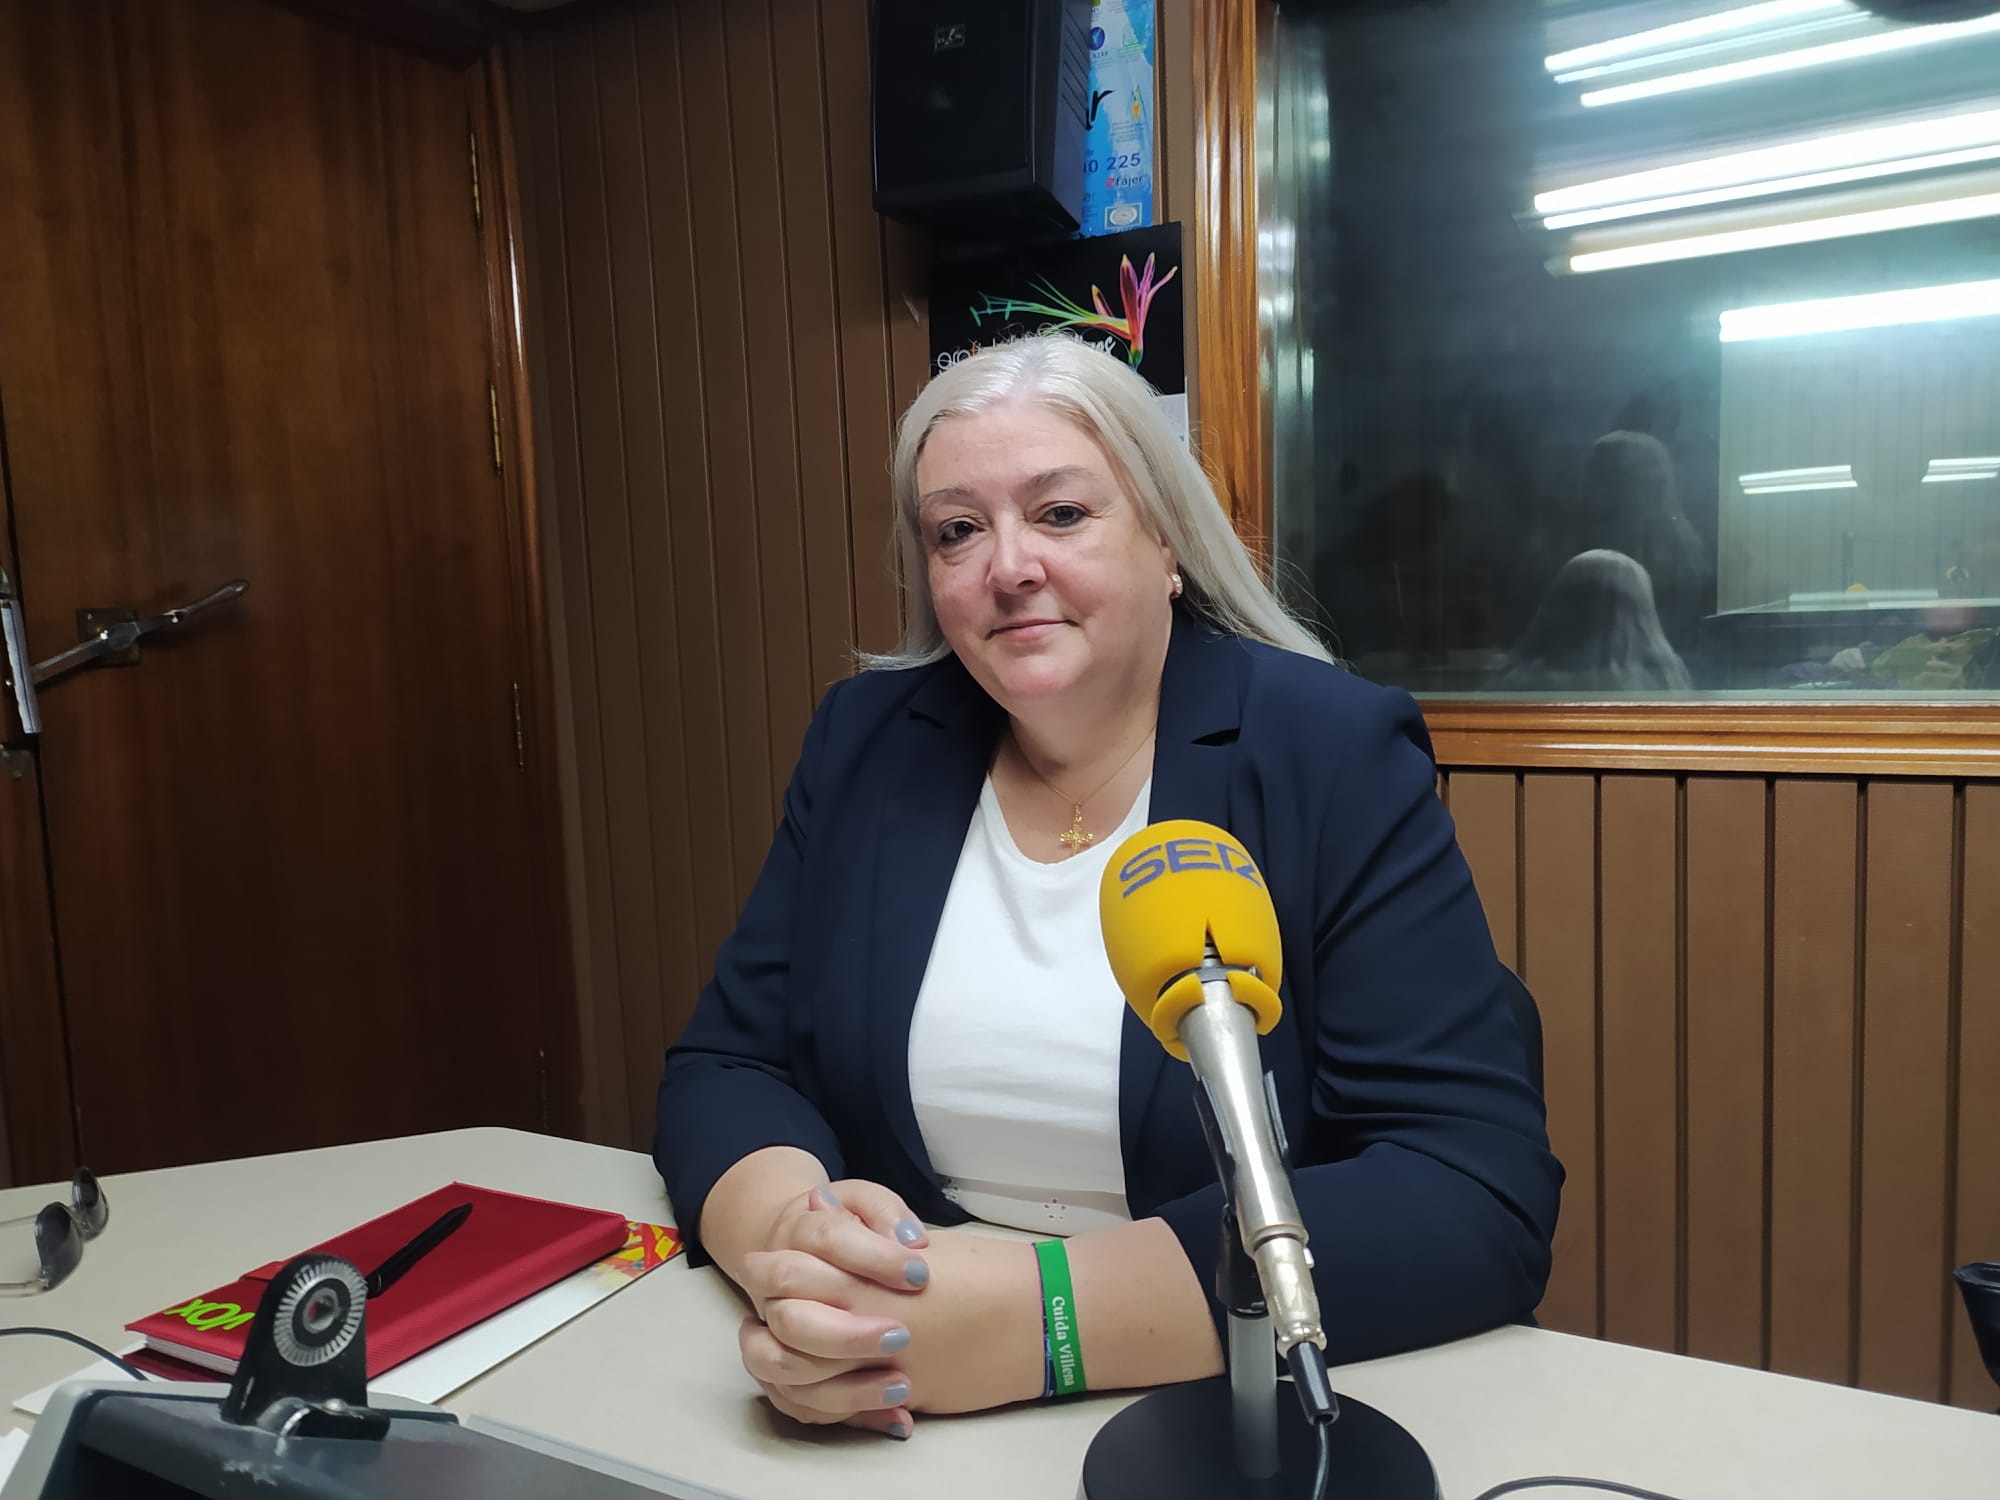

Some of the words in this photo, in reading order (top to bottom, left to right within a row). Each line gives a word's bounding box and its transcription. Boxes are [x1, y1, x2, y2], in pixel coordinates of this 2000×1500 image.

[1106, 152, 1142, 171] 225
[1118, 838, 1263, 900] SER
[1052, 1295, 1069, 1341] Cuida
[1058, 1343, 1076, 1387] Villena
